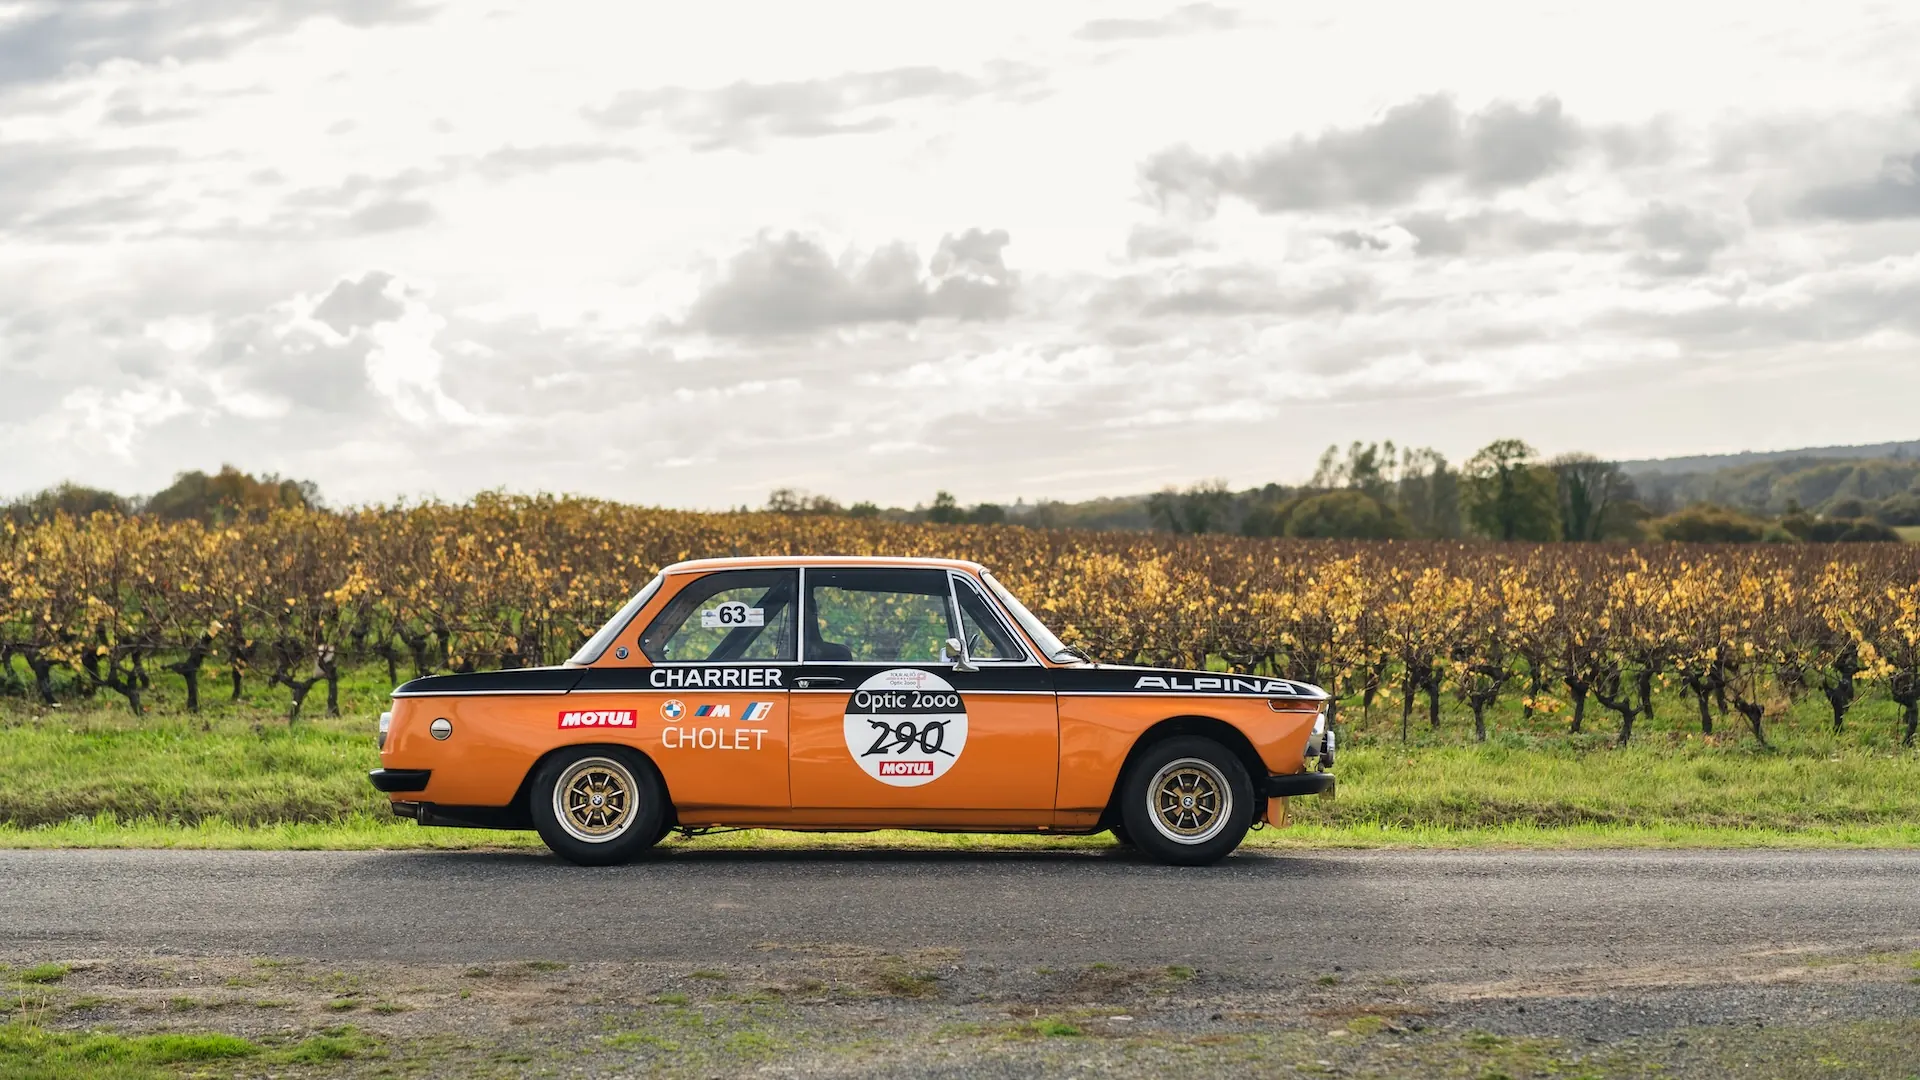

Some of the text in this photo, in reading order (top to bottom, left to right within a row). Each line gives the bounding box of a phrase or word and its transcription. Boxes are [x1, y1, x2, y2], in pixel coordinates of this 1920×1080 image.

[719, 605, 746, 624] 63
[650, 668, 783, 688] CHARRIER
[1134, 676, 1298, 695] ALPINA
[854, 690, 959, 714] Optic 2000
[561, 711, 634, 727] MOTUL
[661, 726, 769, 751] CHOLET
[866, 721, 945, 755] 290
[881, 763, 932, 774] MOTUL
